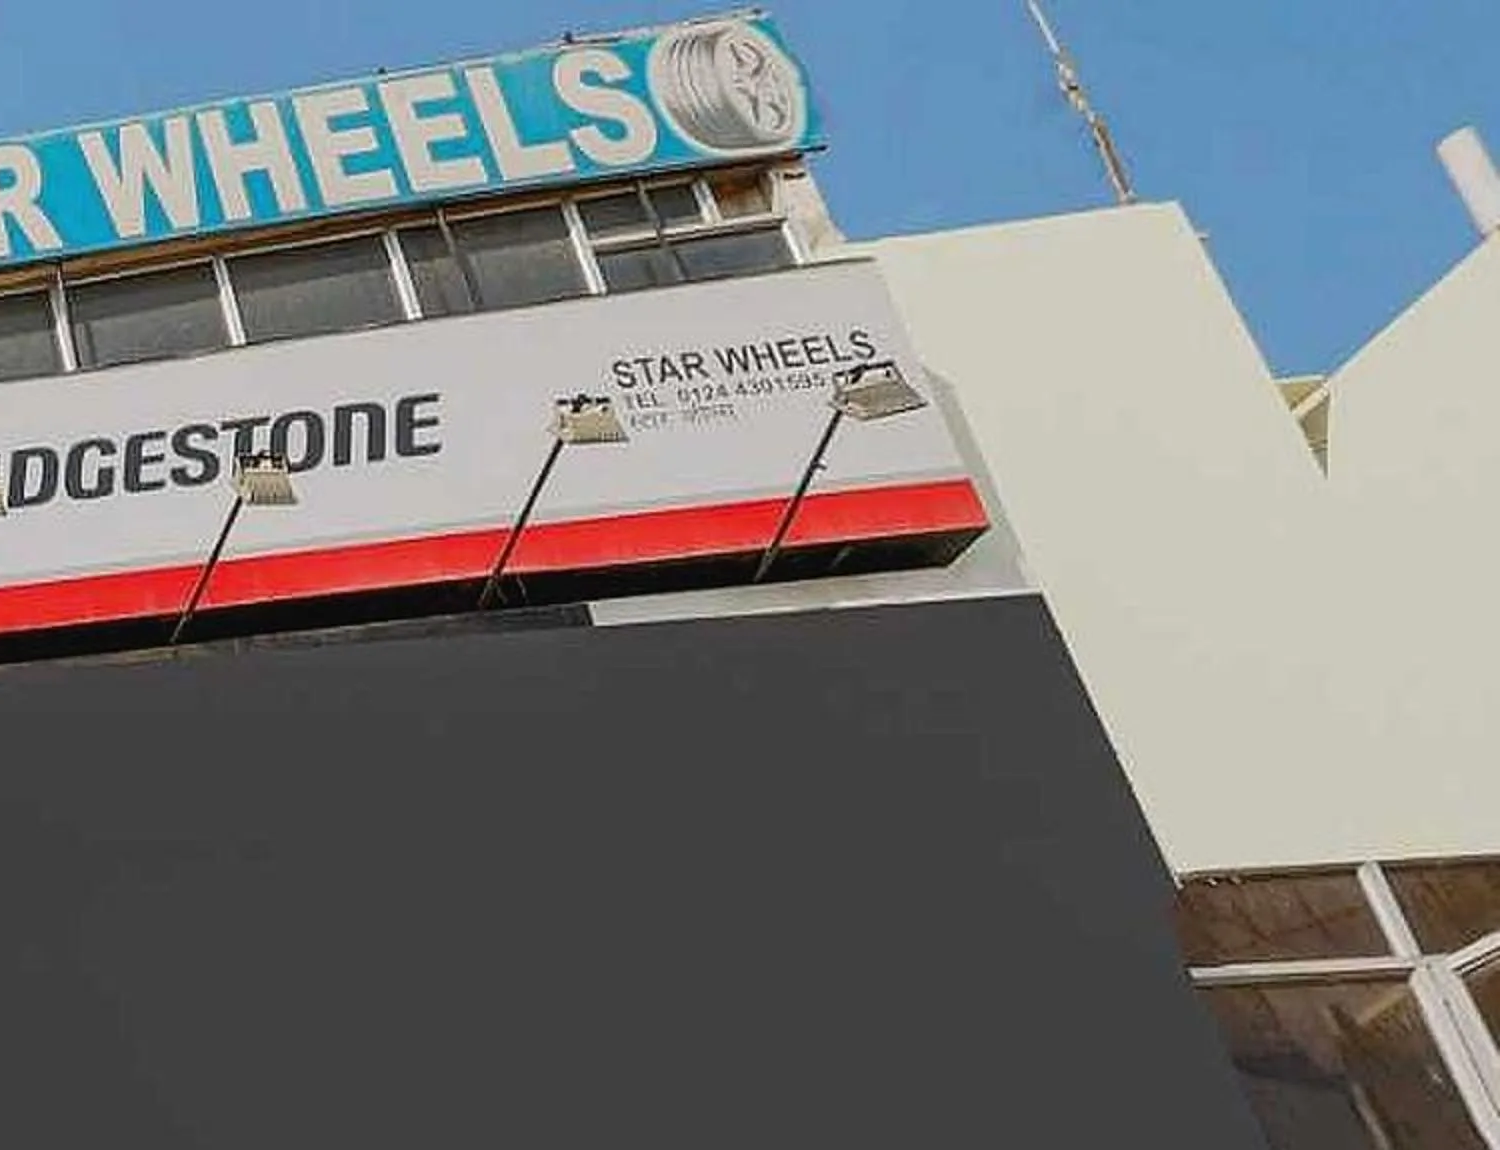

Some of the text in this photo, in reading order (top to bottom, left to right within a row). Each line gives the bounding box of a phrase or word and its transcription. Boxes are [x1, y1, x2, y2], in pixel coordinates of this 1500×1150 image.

[79, 47, 658, 237] WHEELS
[612, 329, 877, 389] STAR WHEELS
